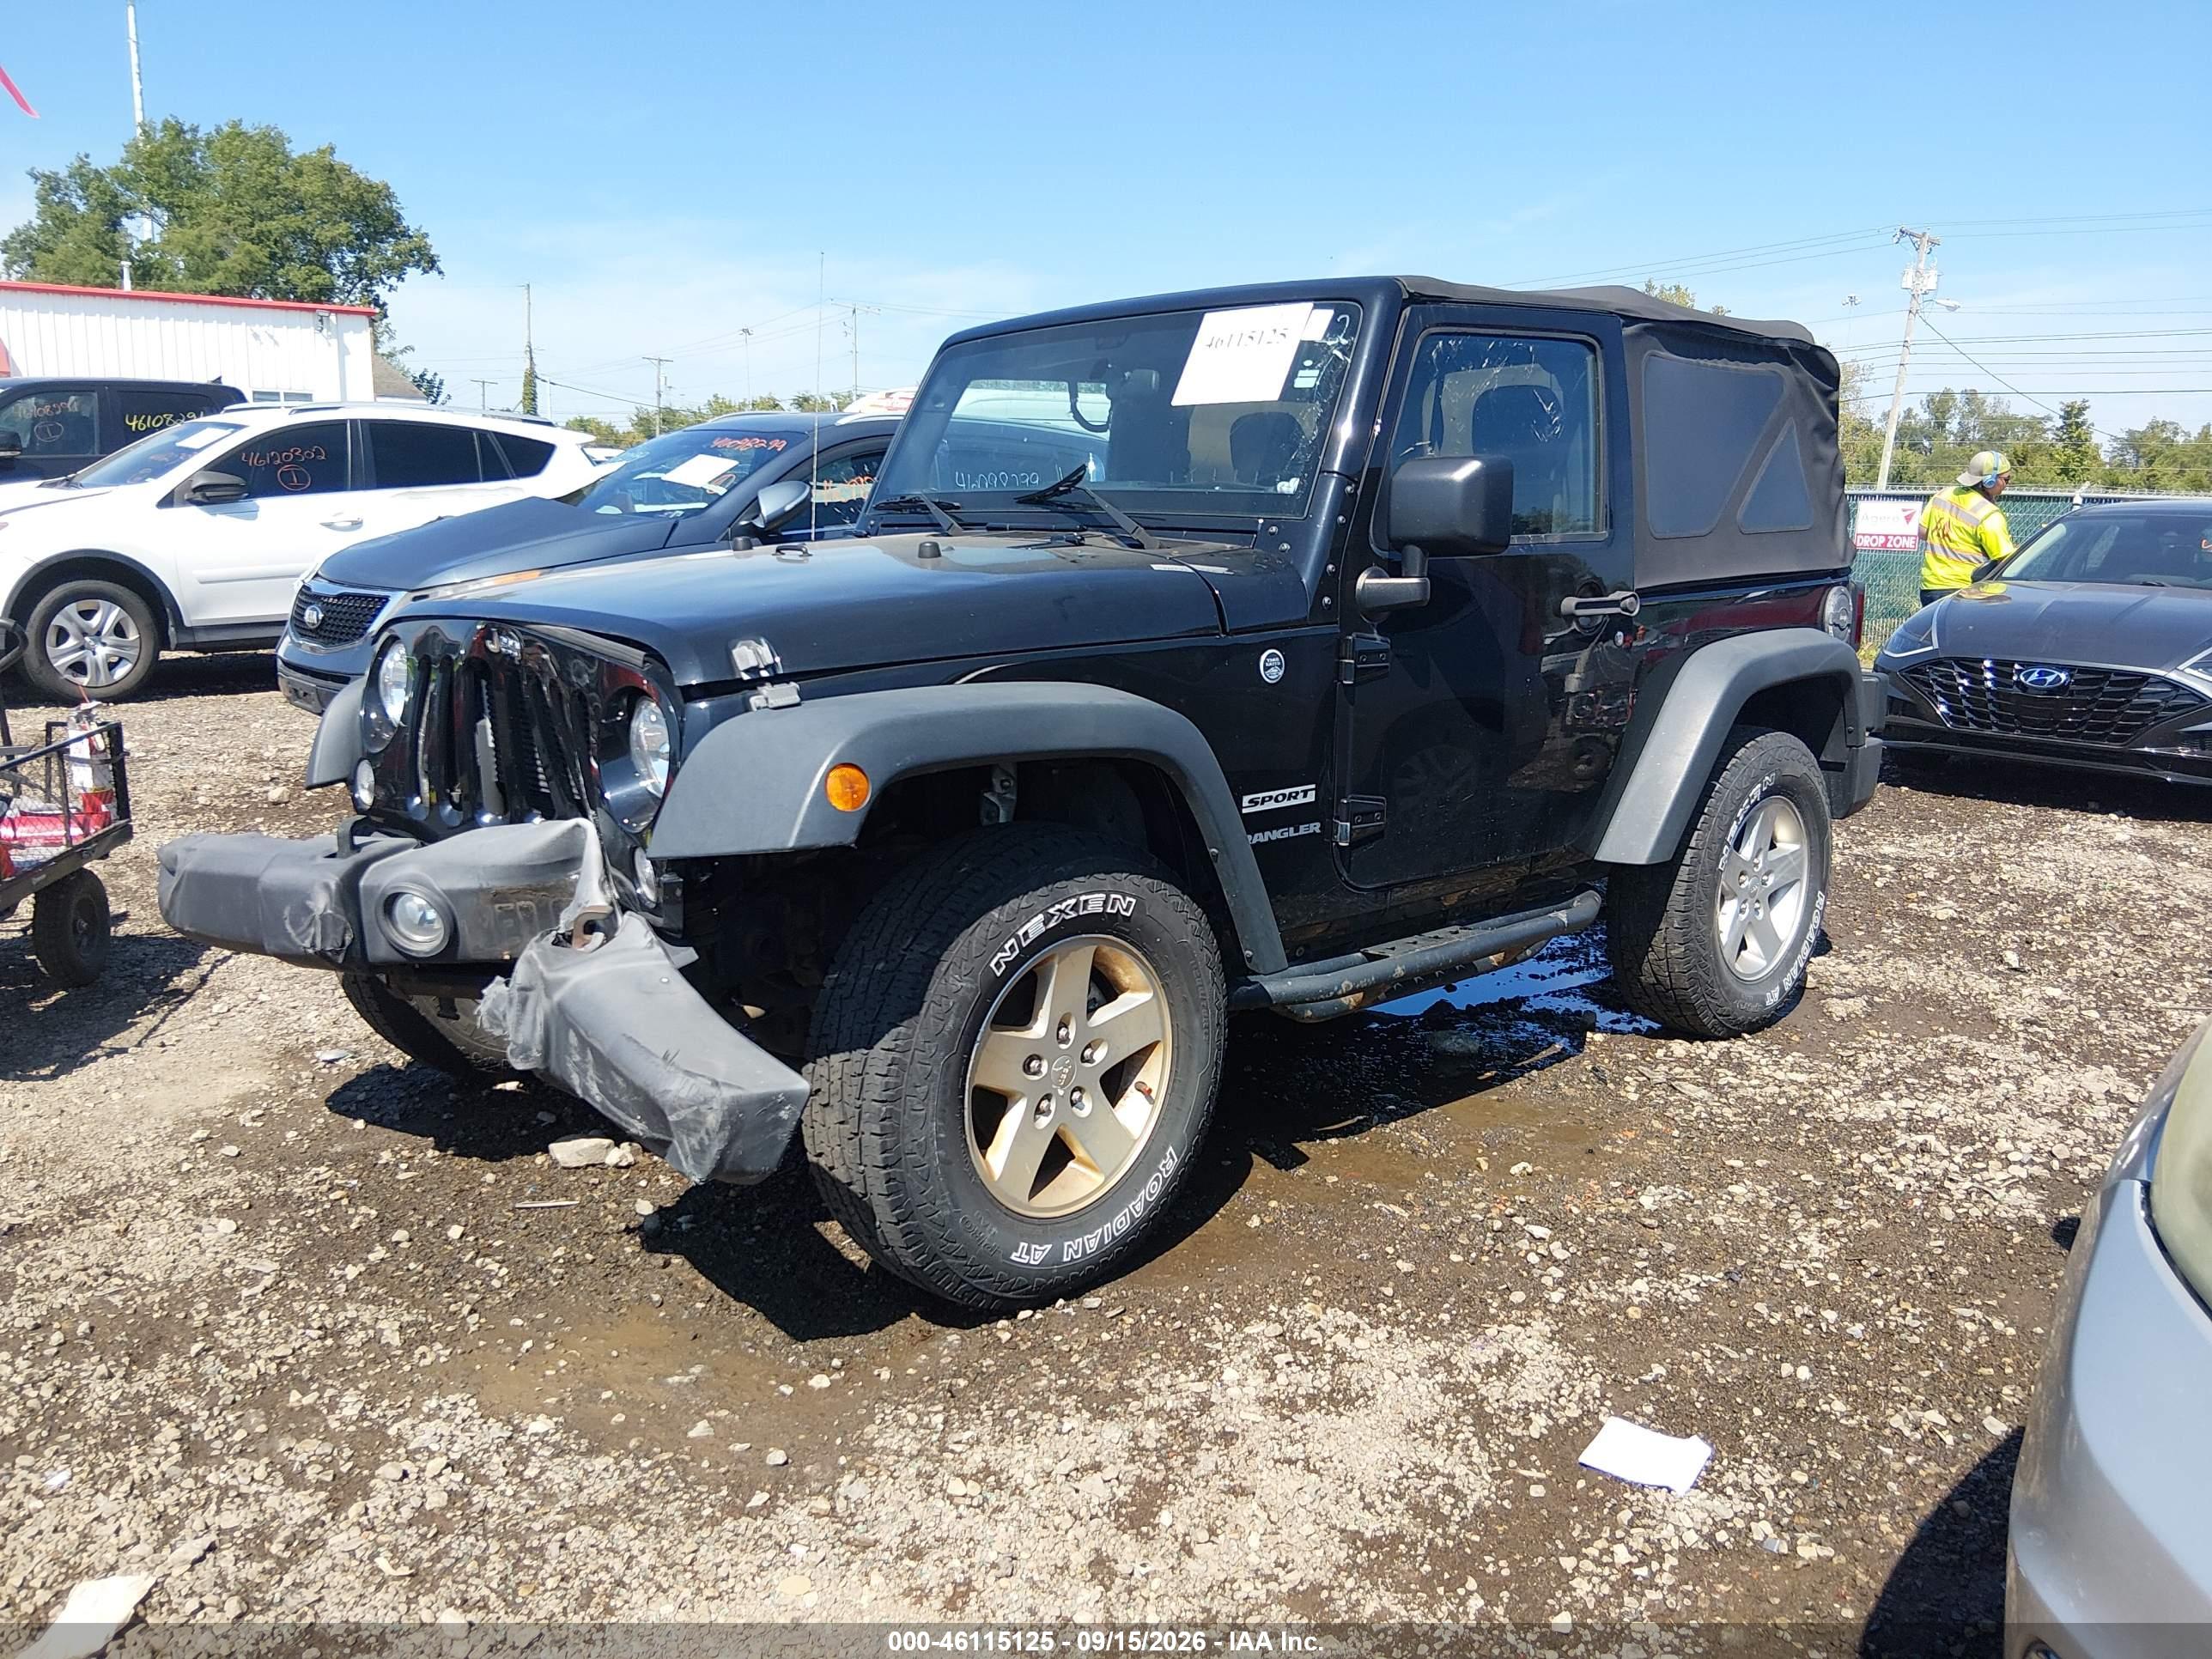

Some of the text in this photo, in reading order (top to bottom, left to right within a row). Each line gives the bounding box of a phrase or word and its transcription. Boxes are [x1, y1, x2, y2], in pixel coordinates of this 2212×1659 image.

[240, 446, 326, 466] 46120302
[1856, 535, 1917, 549] DROP ZONE
[1248, 789, 1311, 808] SPORT
[1248, 823, 1321, 844] RANGLER
[989, 893, 1136, 977] NEXEN
[1765, 890, 1825, 1006] ROADIAN AT
[1063, 1145, 1178, 1261] ROADIAN
[1010, 1242, 1053, 1265] AT
